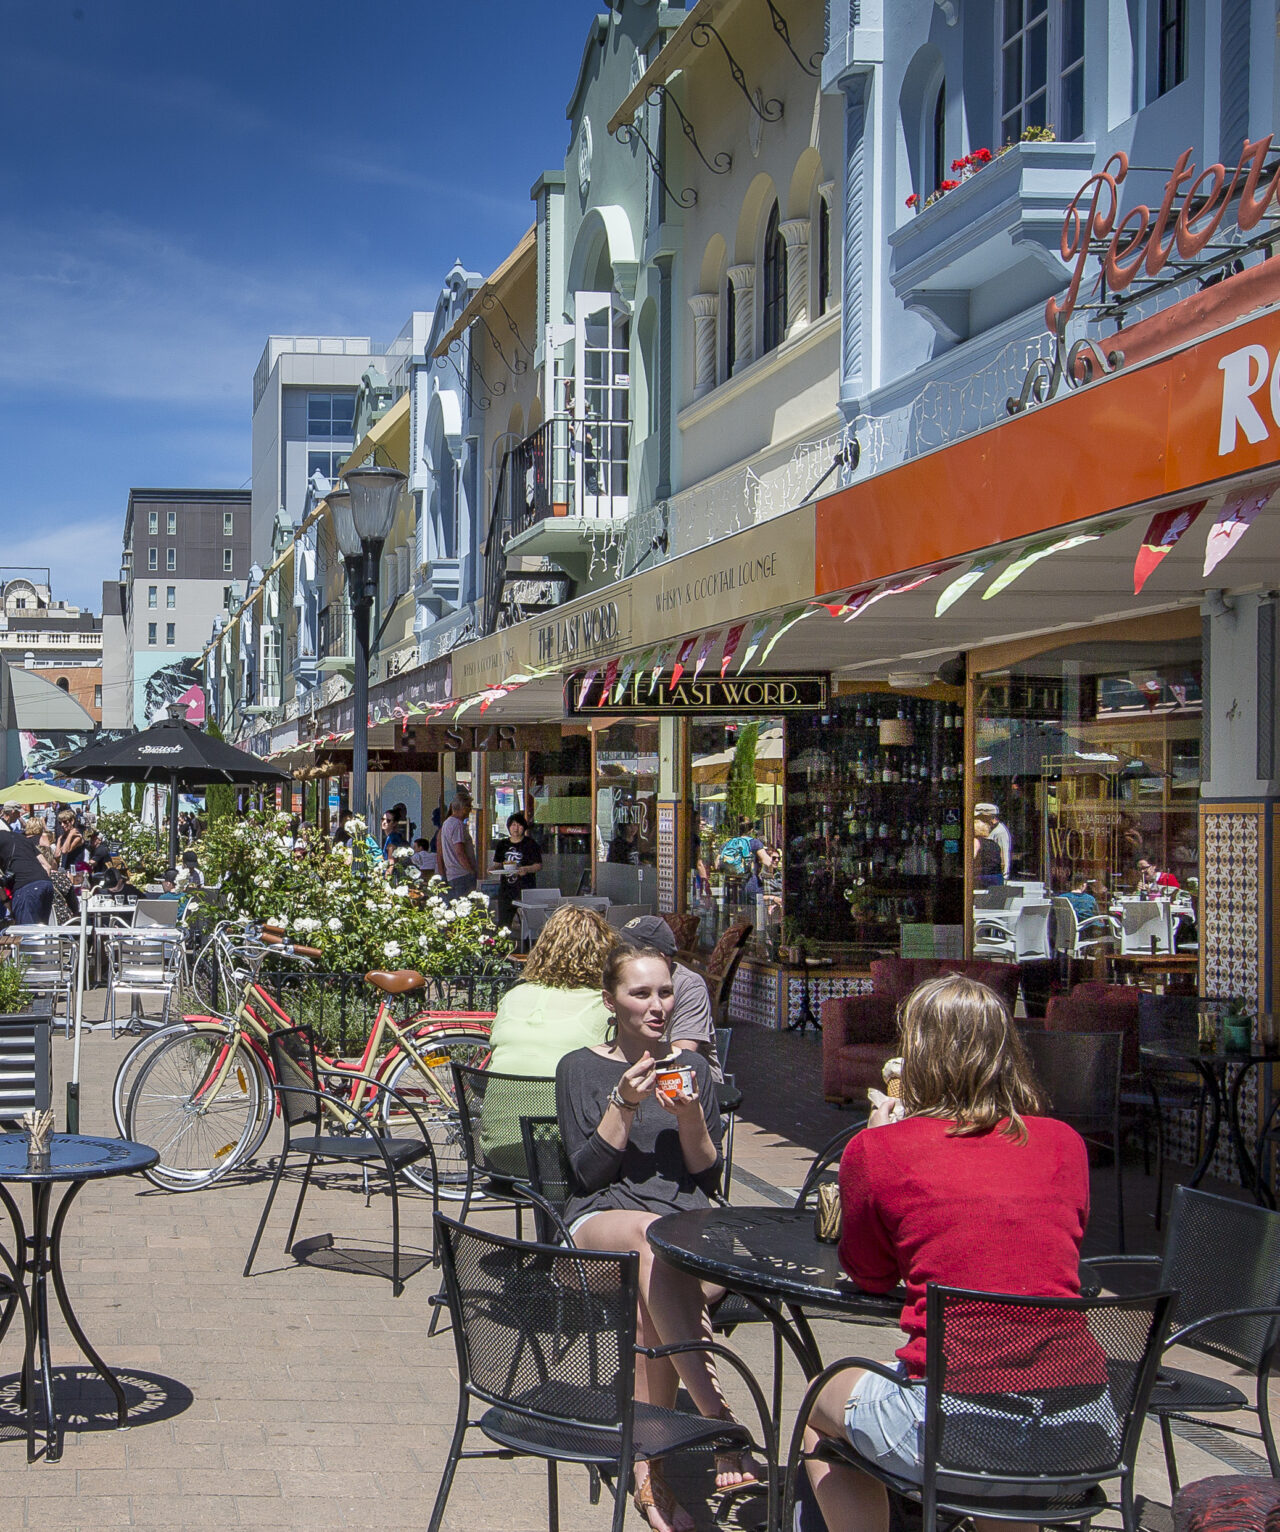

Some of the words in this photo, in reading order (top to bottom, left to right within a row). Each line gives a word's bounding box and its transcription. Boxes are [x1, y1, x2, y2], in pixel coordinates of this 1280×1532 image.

[1045, 133, 1280, 333] Peter
[1218, 344, 1280, 456] R
[694, 567, 735, 601] COCKTAIL
[738, 552, 777, 587] LOUNGE
[538, 626, 553, 661] THE
[557, 614, 580, 653] LAST
[659, 683, 716, 705] LAST
[721, 683, 802, 705] WORD.
